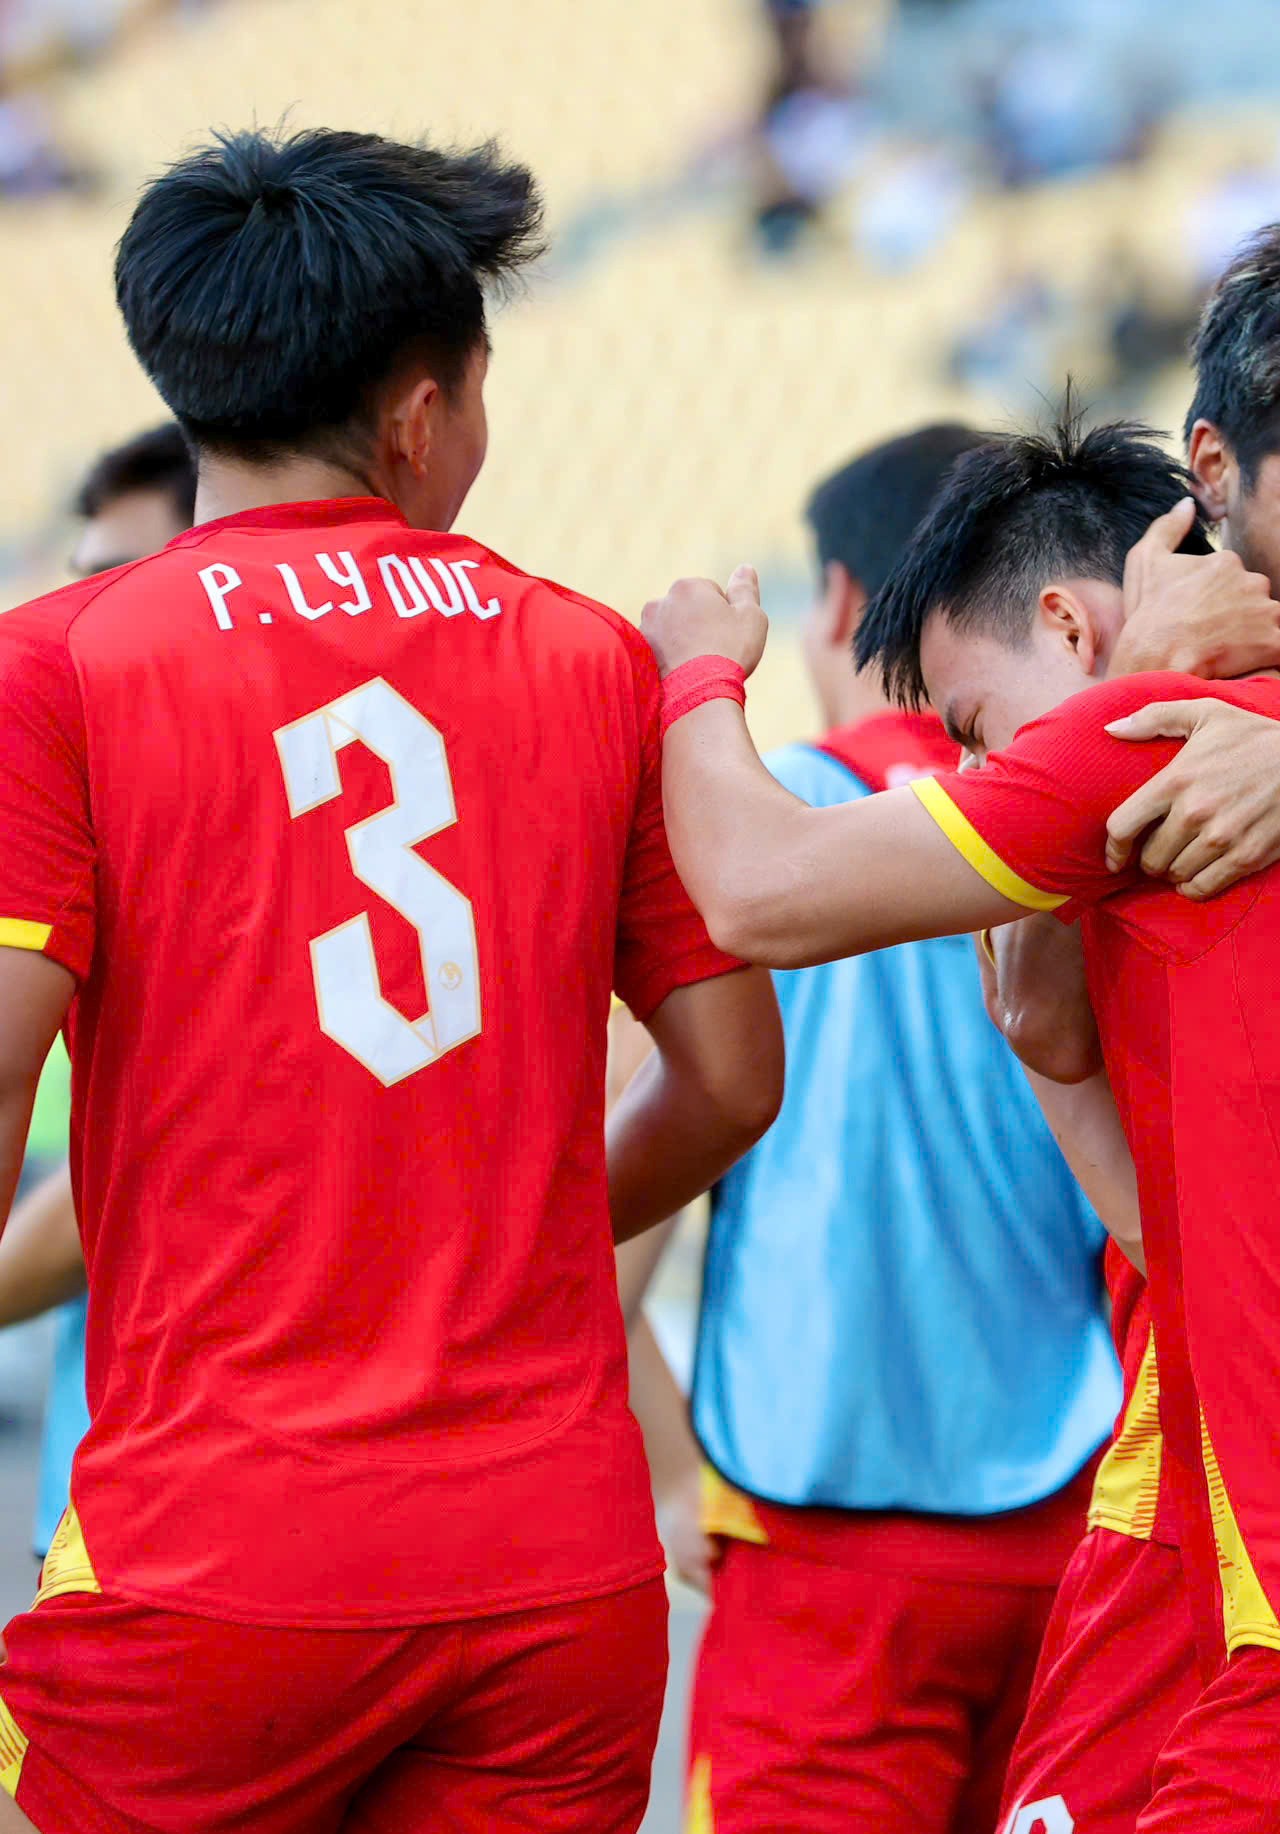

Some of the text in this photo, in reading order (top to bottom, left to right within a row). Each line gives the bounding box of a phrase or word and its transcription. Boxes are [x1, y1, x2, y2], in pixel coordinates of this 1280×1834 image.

[197, 551, 502, 631] P. LY DUC
[273, 676, 482, 1088] 3
